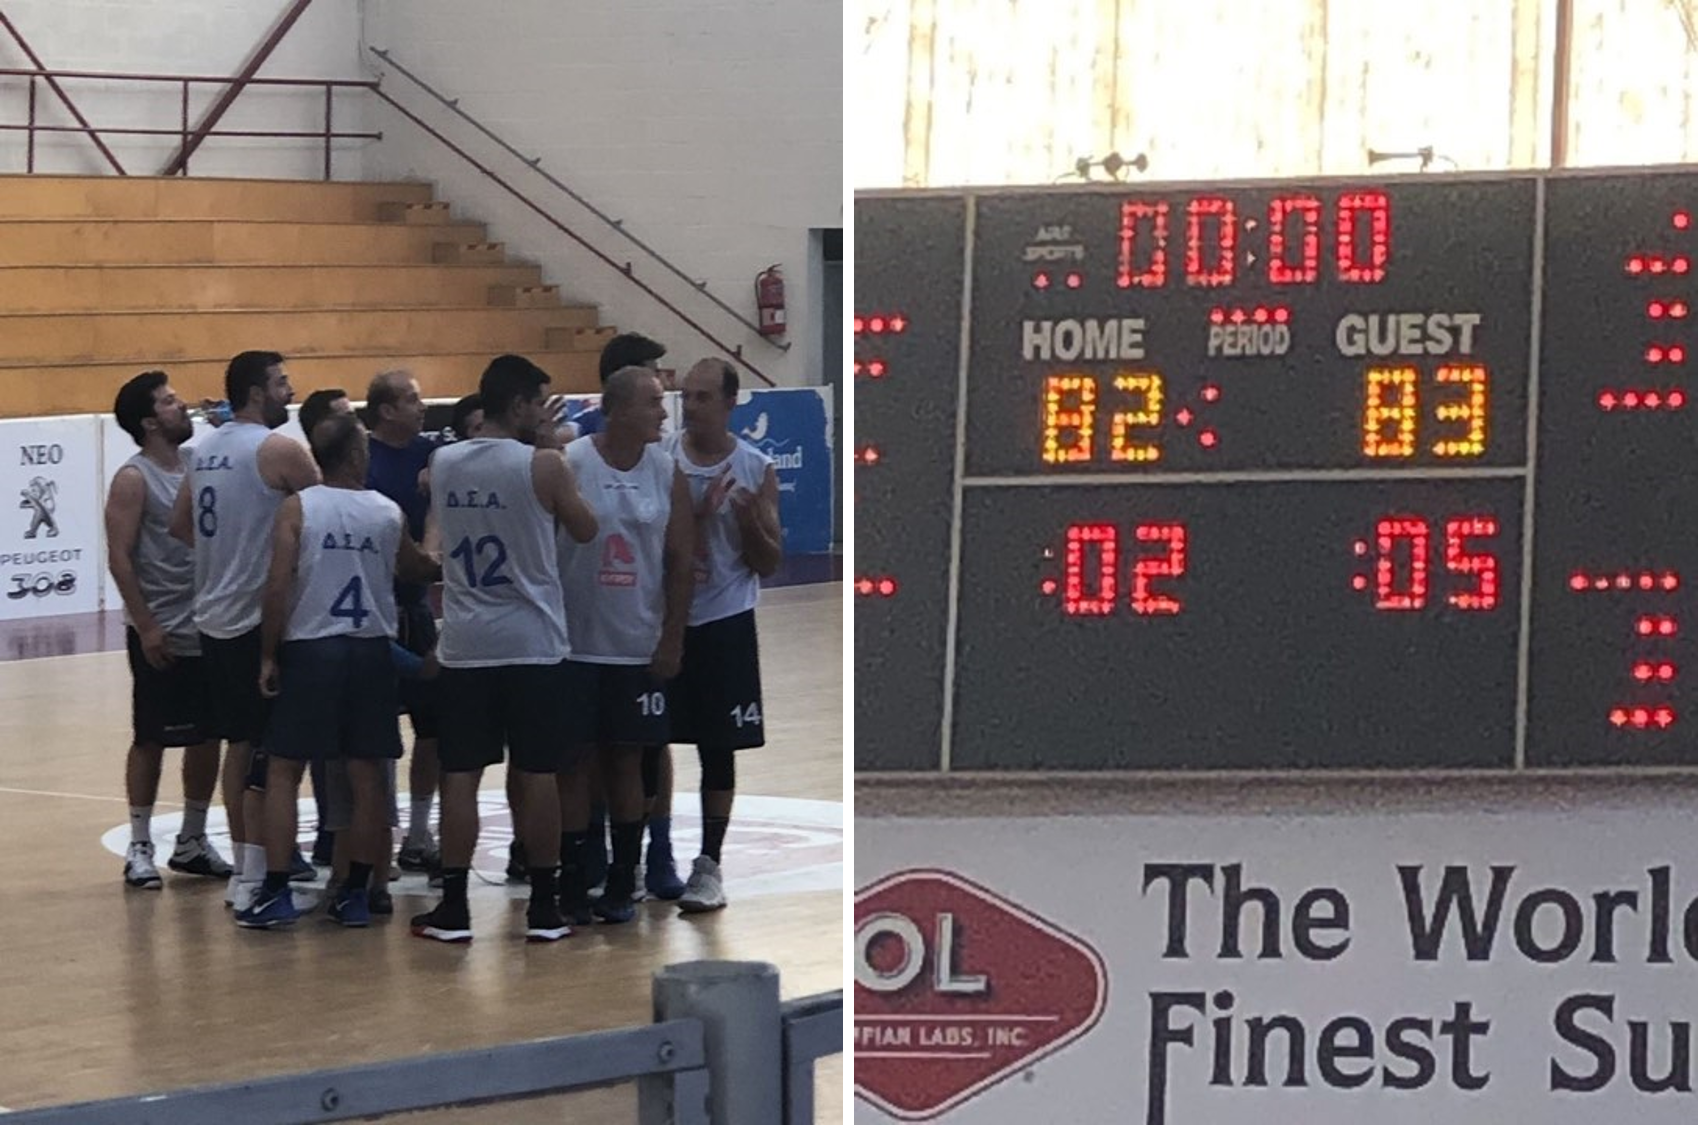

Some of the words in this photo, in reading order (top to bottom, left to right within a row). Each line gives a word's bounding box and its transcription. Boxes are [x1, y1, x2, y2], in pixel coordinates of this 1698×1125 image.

[1115, 190, 1391, 291] 00:00
[1022, 317, 1146, 361] HOME
[1207, 322, 1291, 356] PERIOD
[1335, 313, 1481, 357] GUEST
[1042, 372, 1164, 463] 82
[1362, 364, 1487, 459] 83
[20, 444, 64, 466] NEO
[199, 486, 217, 537] 8
[0, 549, 82, 566] PEUGEOT
[451, 534, 514, 588] 12
[7, 569, 77, 600] 308
[329, 574, 370, 629] 4
[636, 692, 666, 717] 10
[730, 702, 761, 728] 14
[1142, 862, 1351, 961] The
[1147, 989, 1491, 1125] Finest
[1551, 993, 1692, 1093] Su
